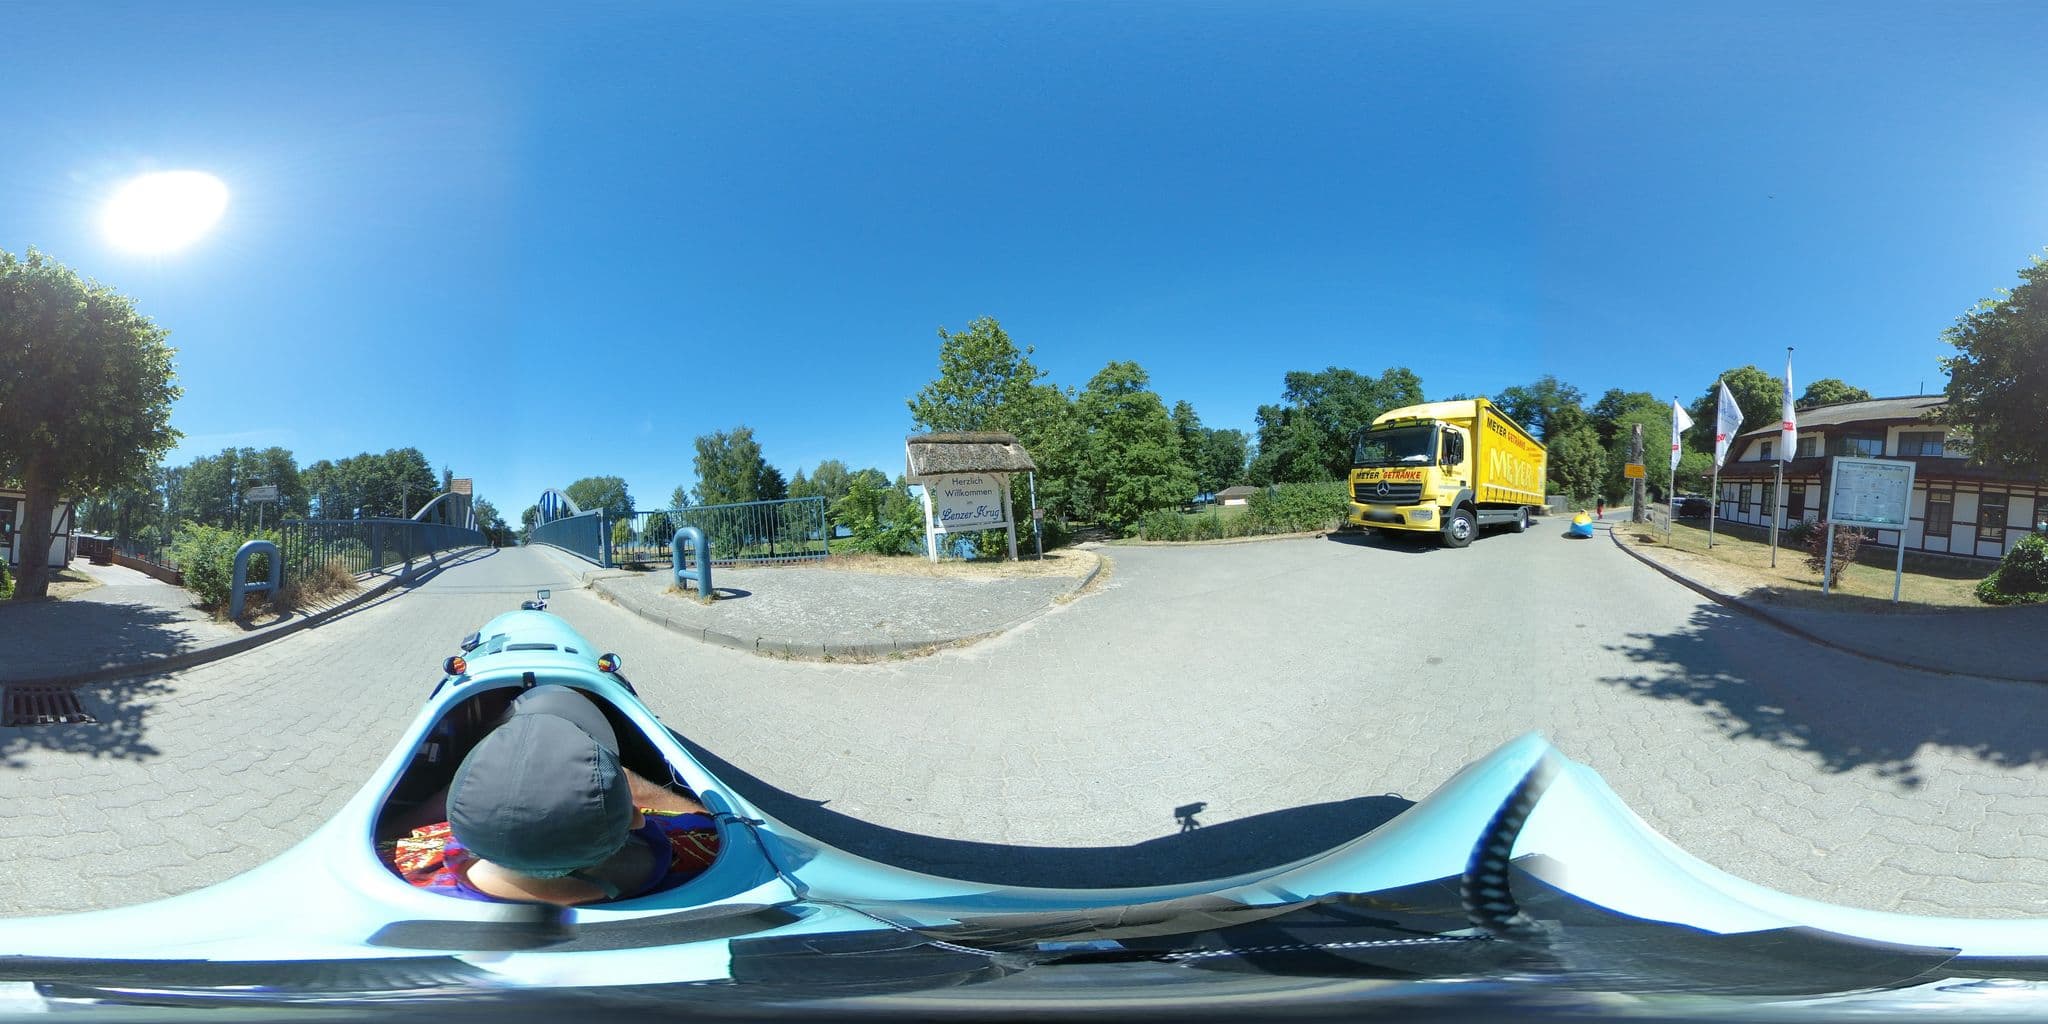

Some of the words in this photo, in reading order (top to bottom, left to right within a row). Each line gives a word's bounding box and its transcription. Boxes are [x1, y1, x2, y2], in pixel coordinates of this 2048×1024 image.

[1487, 416, 1507, 438] MEYER
[1489, 447, 1534, 489] MEYER
[952, 477, 983, 486] Herzlich
[1356, 472, 1380, 480] MEYER
[944, 488, 992, 497] Willkommen
[941, 507, 973, 521] Lenzer
[974, 505, 1000, 520] Krug
